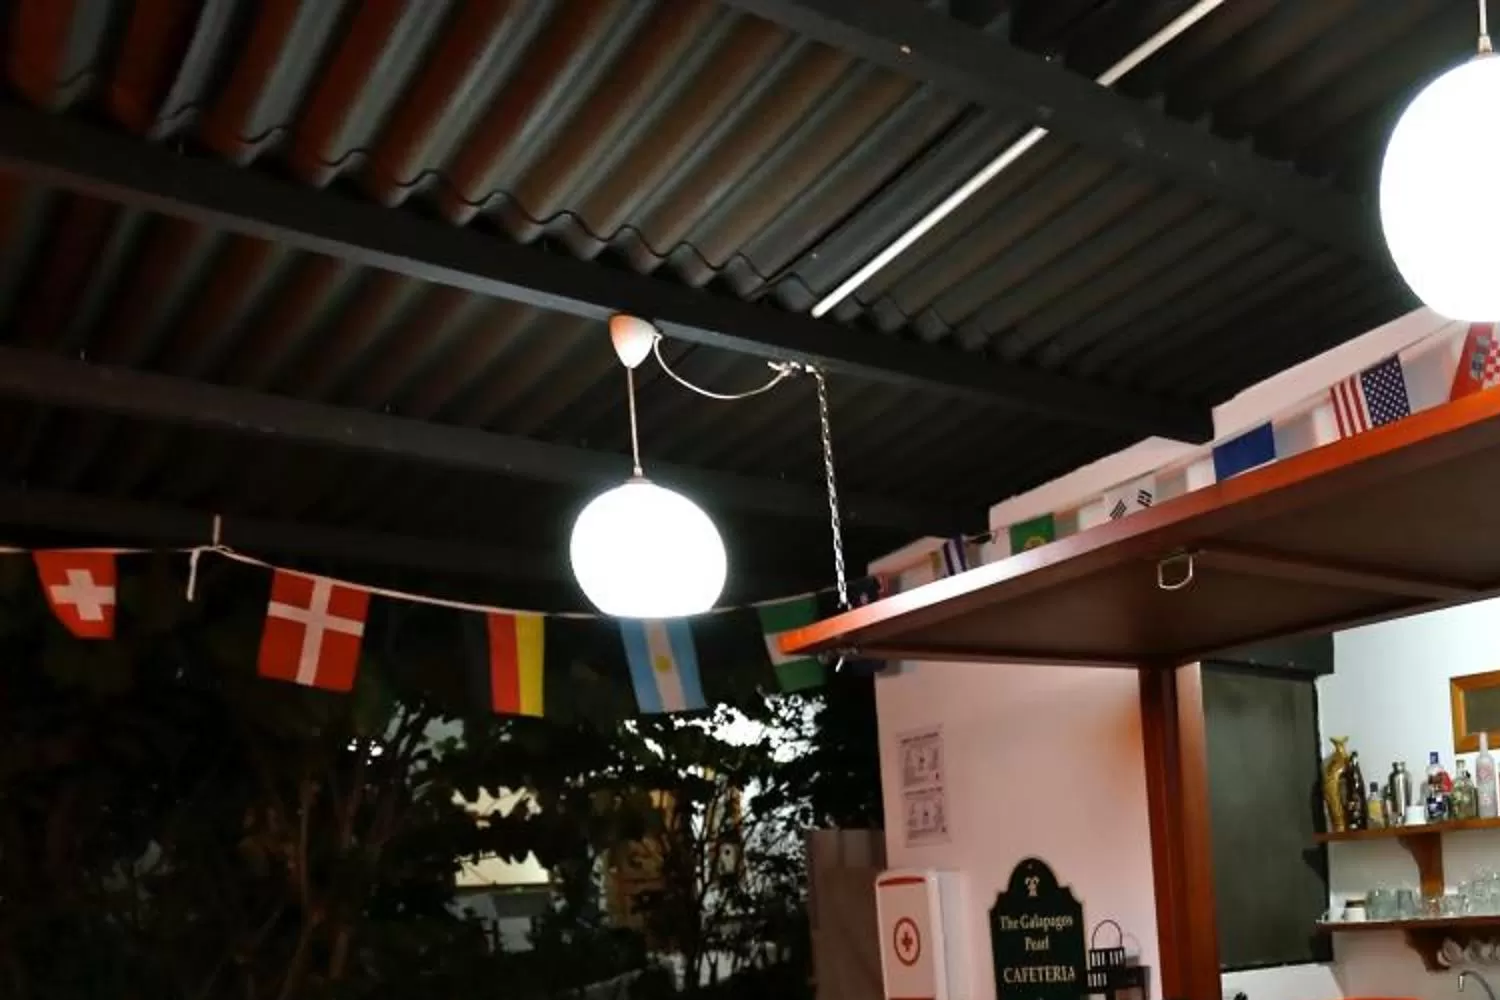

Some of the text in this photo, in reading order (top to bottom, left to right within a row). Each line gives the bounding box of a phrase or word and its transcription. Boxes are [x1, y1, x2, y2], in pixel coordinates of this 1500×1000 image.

[1000, 913, 1074, 932] The Galapagos
[1024, 935, 1049, 951] Pearl
[1003, 965, 1076, 984] CAFETERIA
